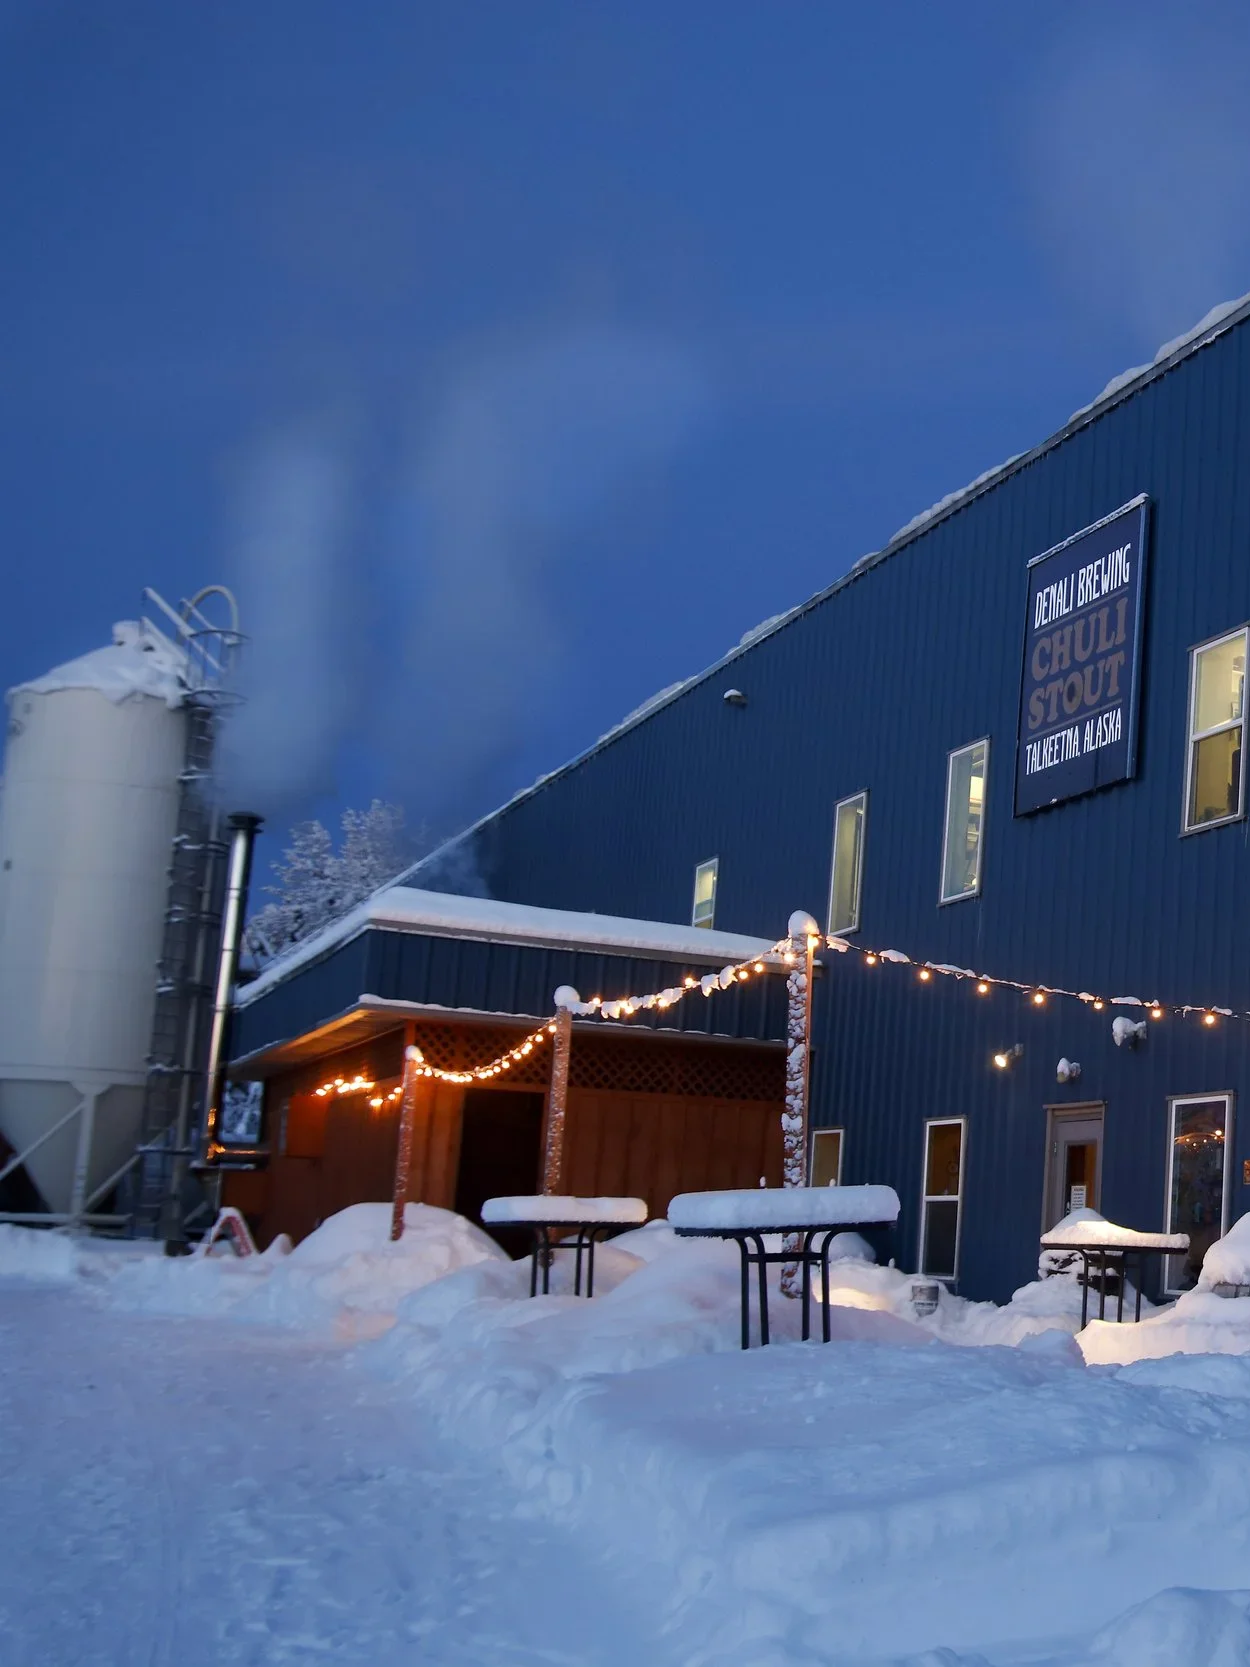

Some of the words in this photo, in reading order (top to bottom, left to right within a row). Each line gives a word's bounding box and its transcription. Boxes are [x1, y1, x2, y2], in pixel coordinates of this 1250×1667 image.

[1034, 573, 1075, 629] DENALI
[1077, 542, 1131, 607] BREWING
[1031, 597, 1130, 681] CHULI
[1027, 650, 1125, 730] STOUT
[1026, 725, 1081, 775] TALKEETNA,
[1083, 707, 1121, 754] ALASKA
